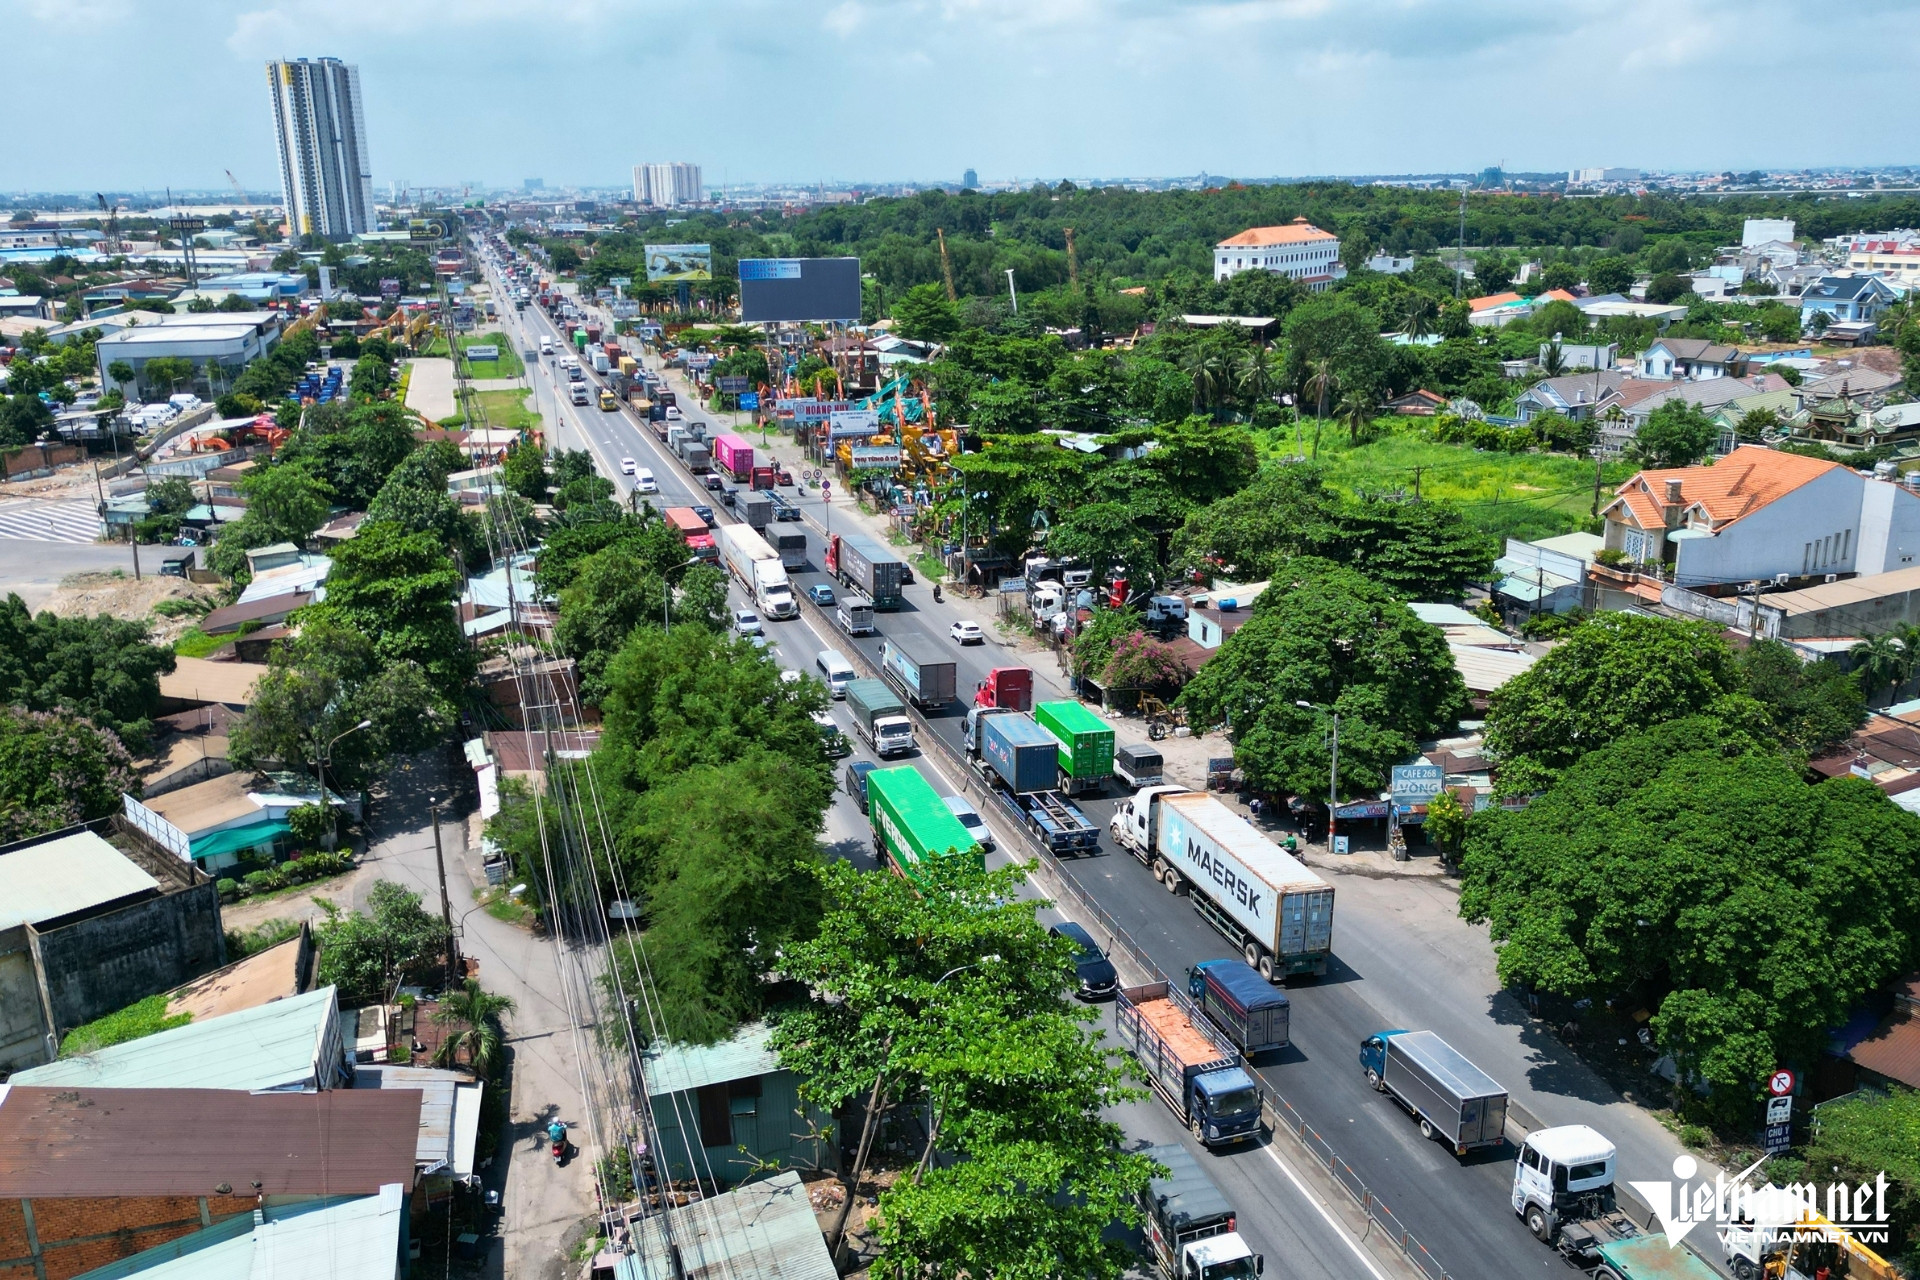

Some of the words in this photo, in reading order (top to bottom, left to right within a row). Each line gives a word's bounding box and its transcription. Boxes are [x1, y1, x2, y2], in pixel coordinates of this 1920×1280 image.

[1402, 769, 1421, 778] CAFE
[1422, 769, 1437, 778] 268
[1188, 837, 1261, 919] MAERSK
[1768, 1126, 1783, 1138] CHÚ
[1785, 1124, 1790, 1135] Ý
